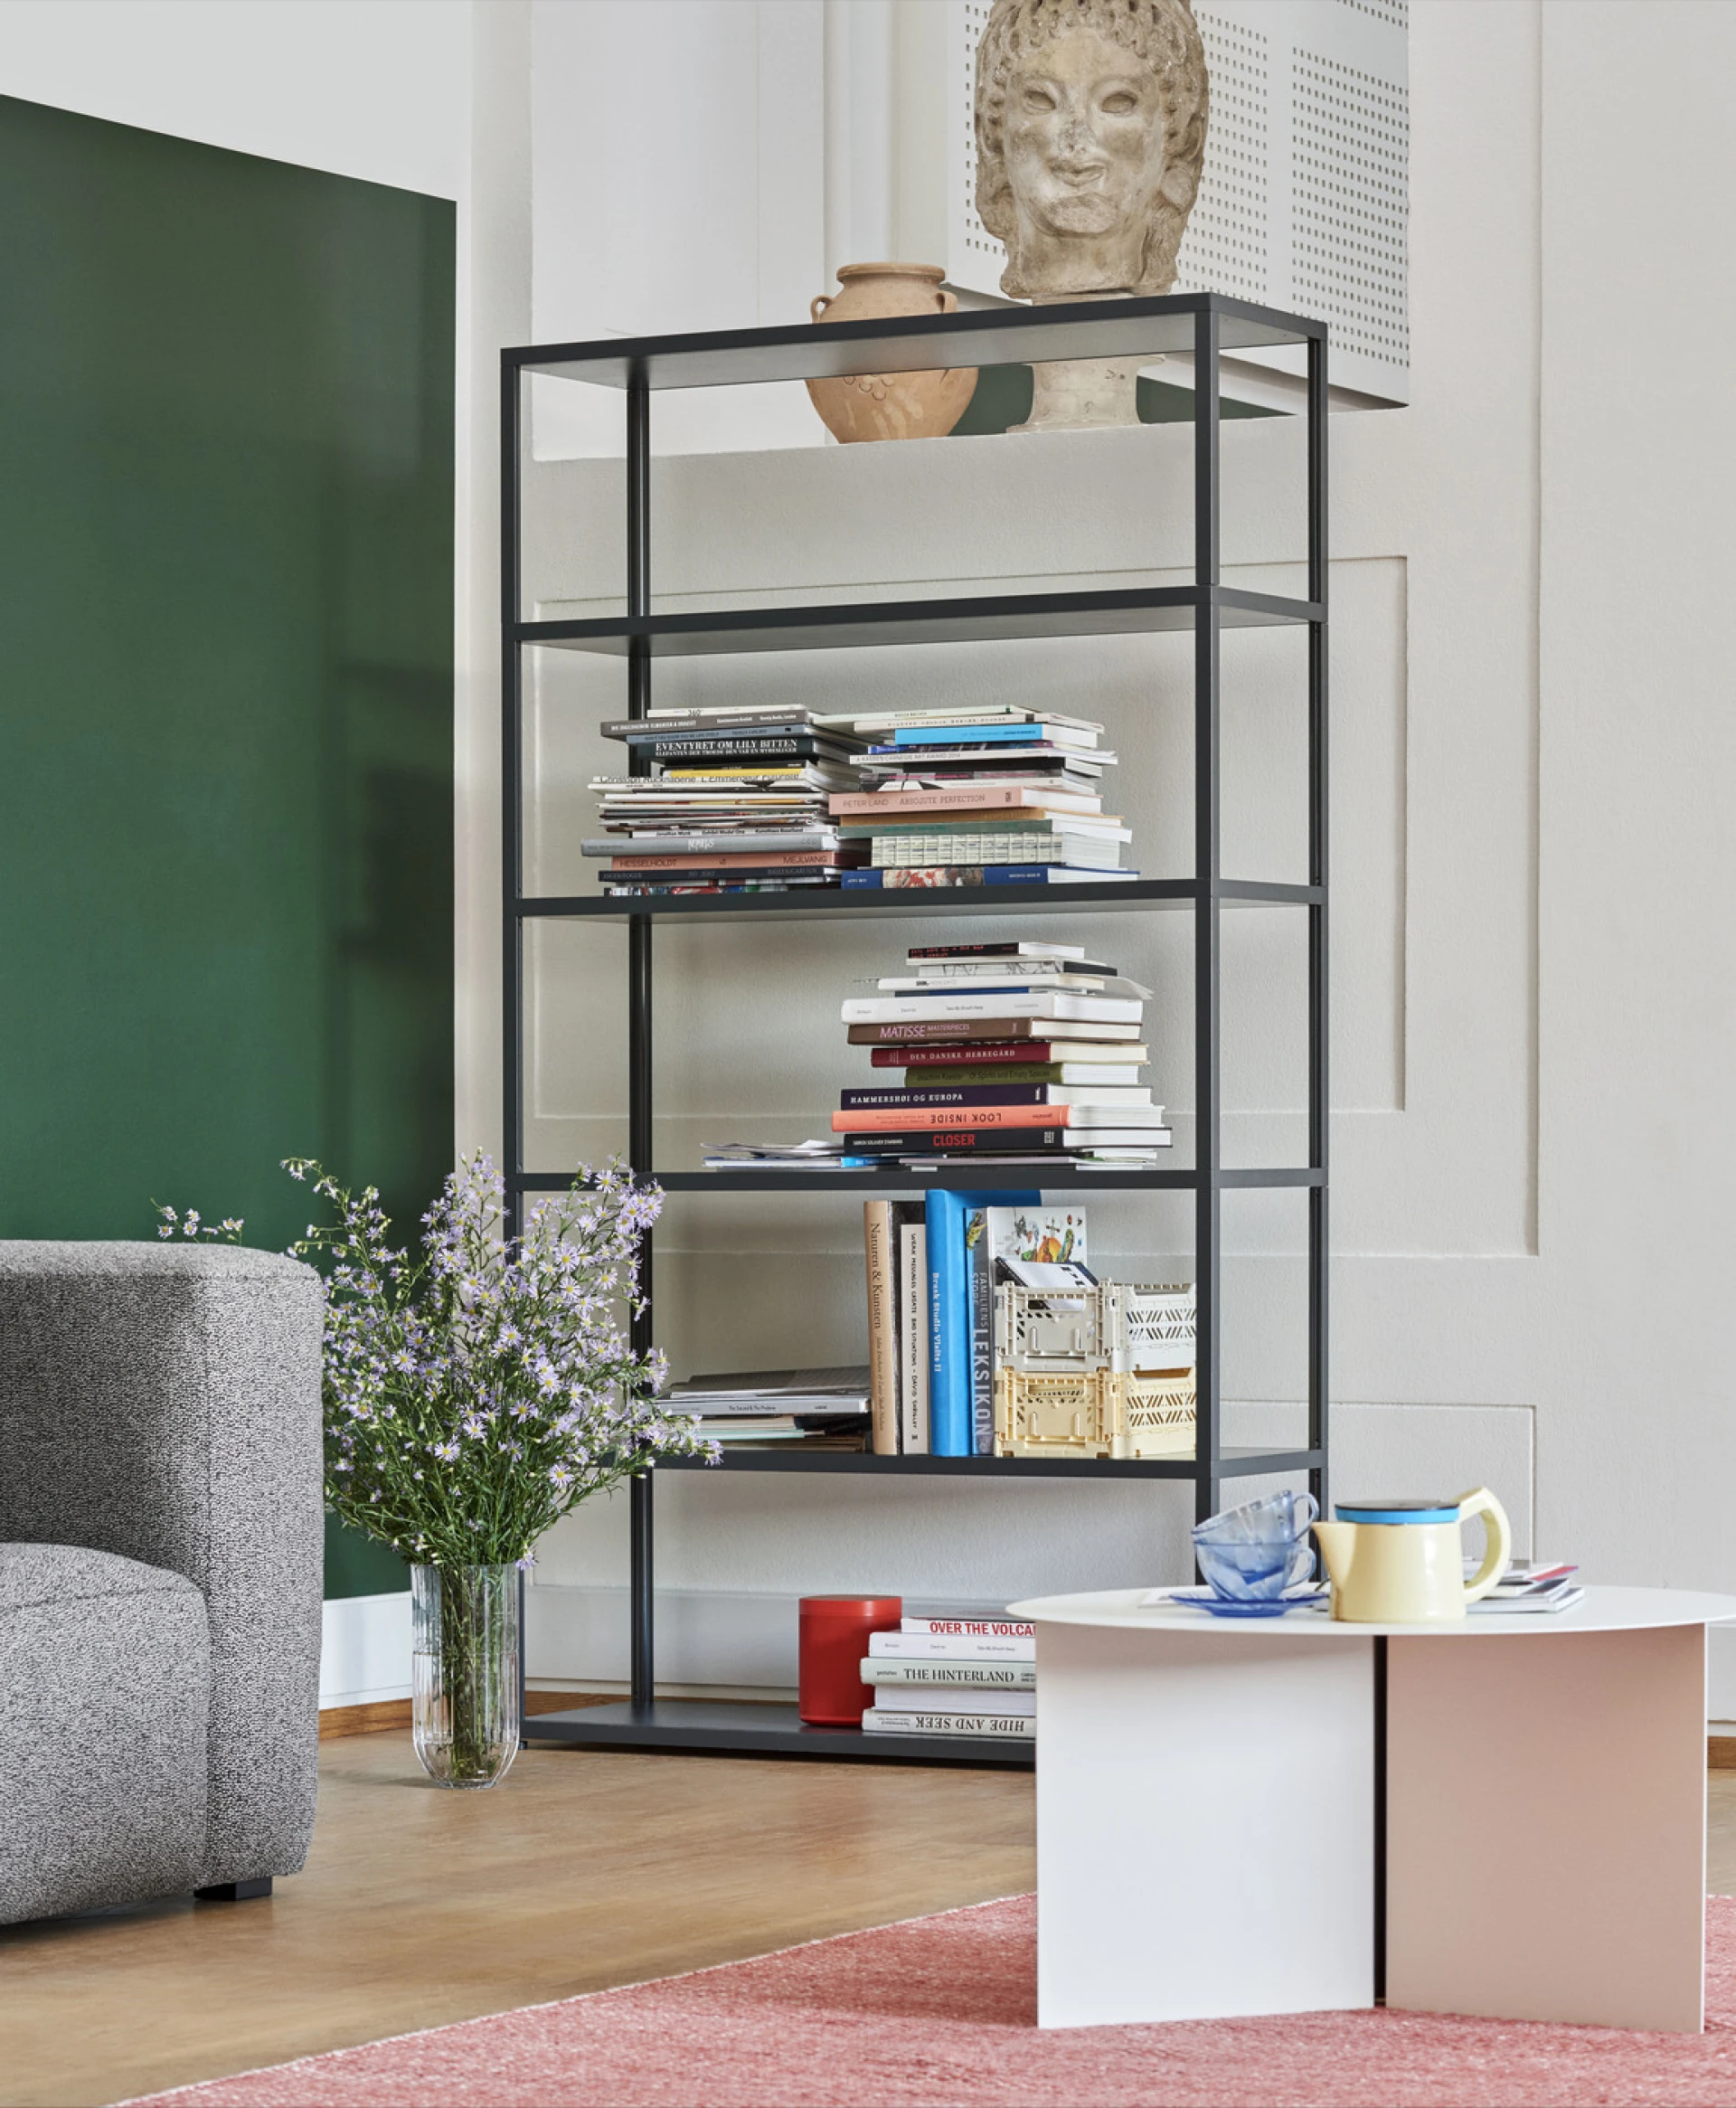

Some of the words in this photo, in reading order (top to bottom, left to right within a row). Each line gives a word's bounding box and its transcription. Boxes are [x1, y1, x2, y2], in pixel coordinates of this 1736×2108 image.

[656, 742, 717, 752] EVENTYRET
[718, 741, 733, 750] OM
[736, 741, 758, 749] LILY
[760, 739, 797, 748] BITTEN
[843, 799, 866, 808] PETER
[867, 798, 889, 807] LAND
[939, 794, 986, 803] PERFECTION
[620, 859, 676, 867] HESSELHOLDT
[880, 1025, 926, 1038] MATISSE
[929, 1051, 963, 1059] DANSKE
[965, 1049, 1015, 1058] HERREGÅRD
[850, 1095, 910, 1103] HAMMERSHØI
[928, 1092, 963, 1101] EUROPA
[930, 1114, 967, 1123] INSIDE
[972, 1113, 1002, 1122] LOOK
[933, 1134, 976, 1148] CLOSER
[870, 1223, 881, 1268] Naturen
[872, 1270, 882, 1281] &
[872, 1284, 882, 1329] Kunsten
[979, 1272, 988, 1329] FAMILIENS
[934, 1364, 941, 1372] II
[974, 1329, 991, 1435] LEKSIKON
[929, 1621, 962, 1634] OVER
[965, 1622, 989, 1635] THE
[991, 1623, 1035, 1636] VOLCA
[903, 1668, 929, 1680] THE
[932, 1669, 1014, 1682] HINTERLAND
[915, 1716, 952, 1728] SEEK
[956, 1718, 985, 1729] AND
[989, 1719, 1024, 1732] HIDE
